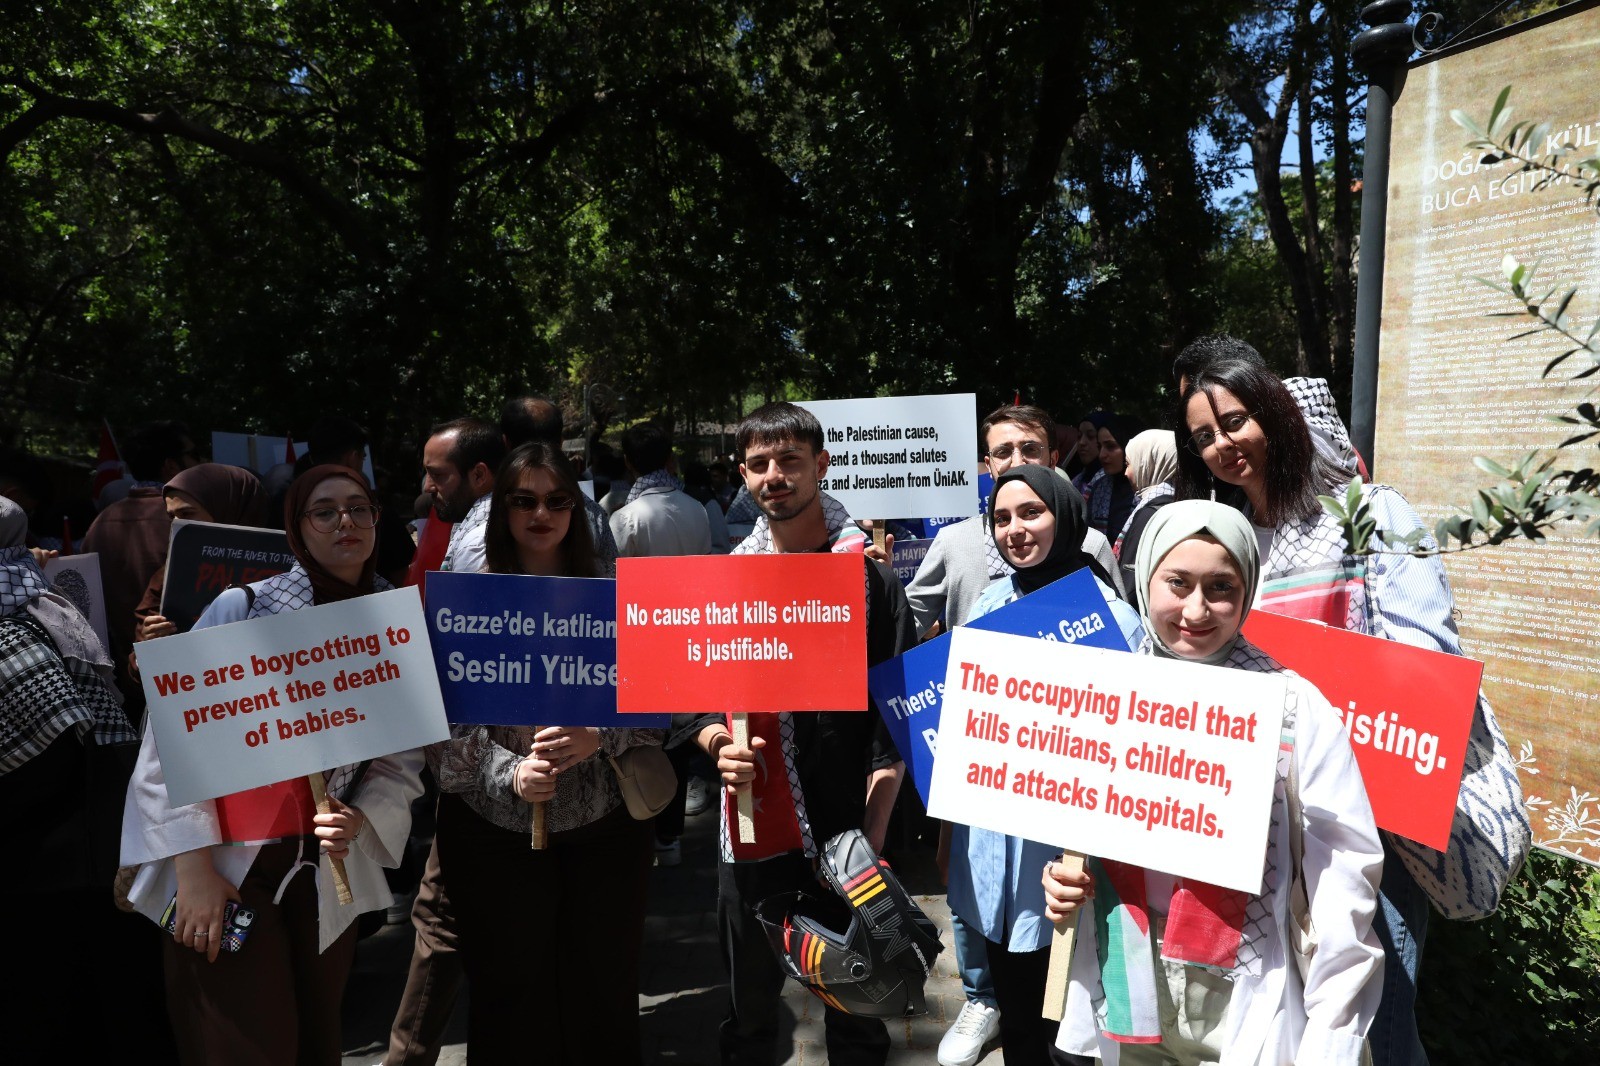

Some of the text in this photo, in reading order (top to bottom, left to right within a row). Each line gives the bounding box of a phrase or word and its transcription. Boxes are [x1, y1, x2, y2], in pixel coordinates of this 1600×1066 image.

[1421, 184, 1481, 215] BUCA
[827, 425, 939, 443] the Palestinian cause,
[852, 455, 858, 466] a
[861, 448, 907, 466] thousand
[909, 448, 947, 464] salutes
[832, 474, 850, 491] and
[853, 473, 905, 490] Jerusalem
[907, 472, 931, 488] from
[933, 467, 969, 487] ÜniAK.
[201, 545, 226, 558] FROM
[227, 548, 243, 559] THE
[244, 550, 267, 563] RIVER
[269, 552, 281, 563] TO
[626, 599, 851, 626] No cause that kills civilians
[1058, 612, 1106, 644] Gaza
[153, 626, 411, 697] We are boycotting to
[447, 651, 531, 684] Sesini
[687, 637, 793, 668] is justifiable.
[183, 660, 401, 733] prevent the death
[959, 661, 1258, 743] The occupying Israel that
[245, 705, 366, 748] of babies.
[1332, 700, 1447, 776] isting.
[965, 708, 1010, 744] kills
[1016, 721, 1117, 773] civilians,
[1125, 741, 1232, 797] children,
[966, 761, 1224, 839] and attacks hospitals.
